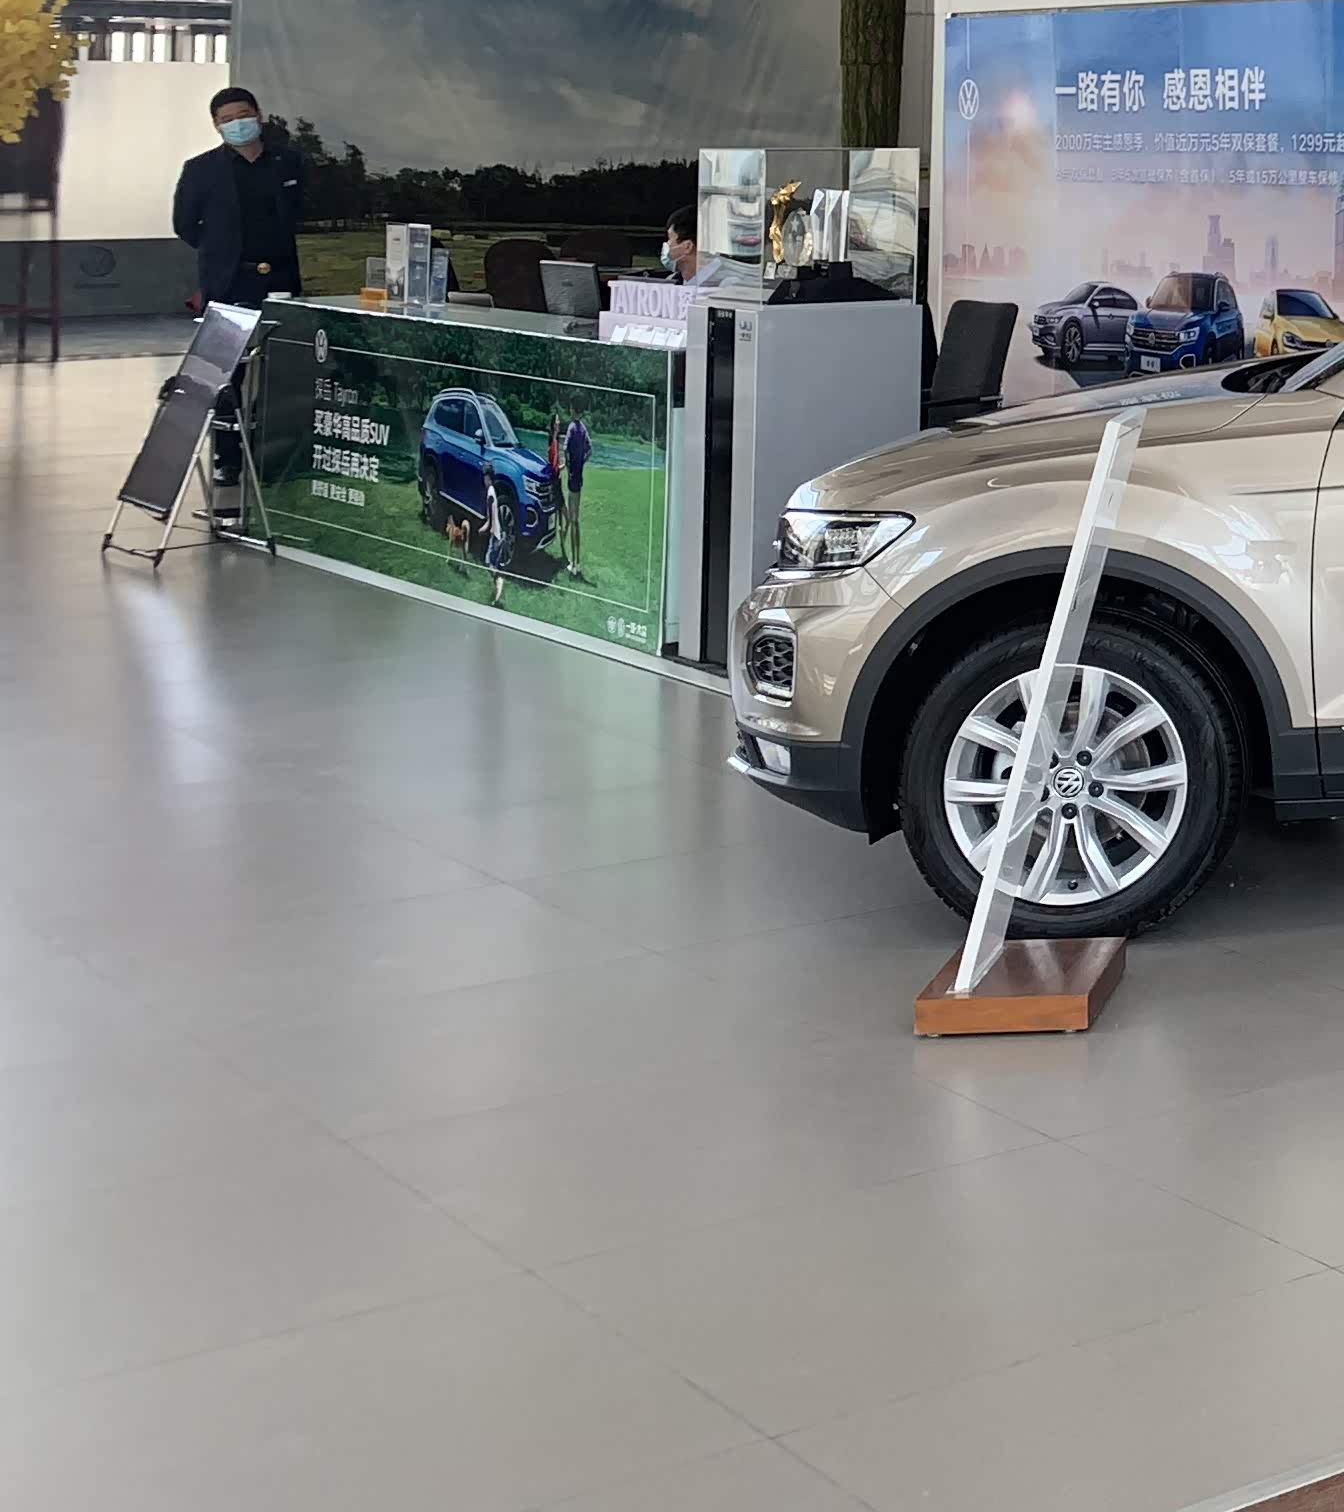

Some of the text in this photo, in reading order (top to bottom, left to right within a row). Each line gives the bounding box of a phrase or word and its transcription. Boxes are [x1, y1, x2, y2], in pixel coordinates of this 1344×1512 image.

[1055, 66, 1267, 113] 一路有你 感恩相伴
[608, 281, 674, 319] TAYRON
[313, 409, 391, 446] 买豪华高品质SUV
